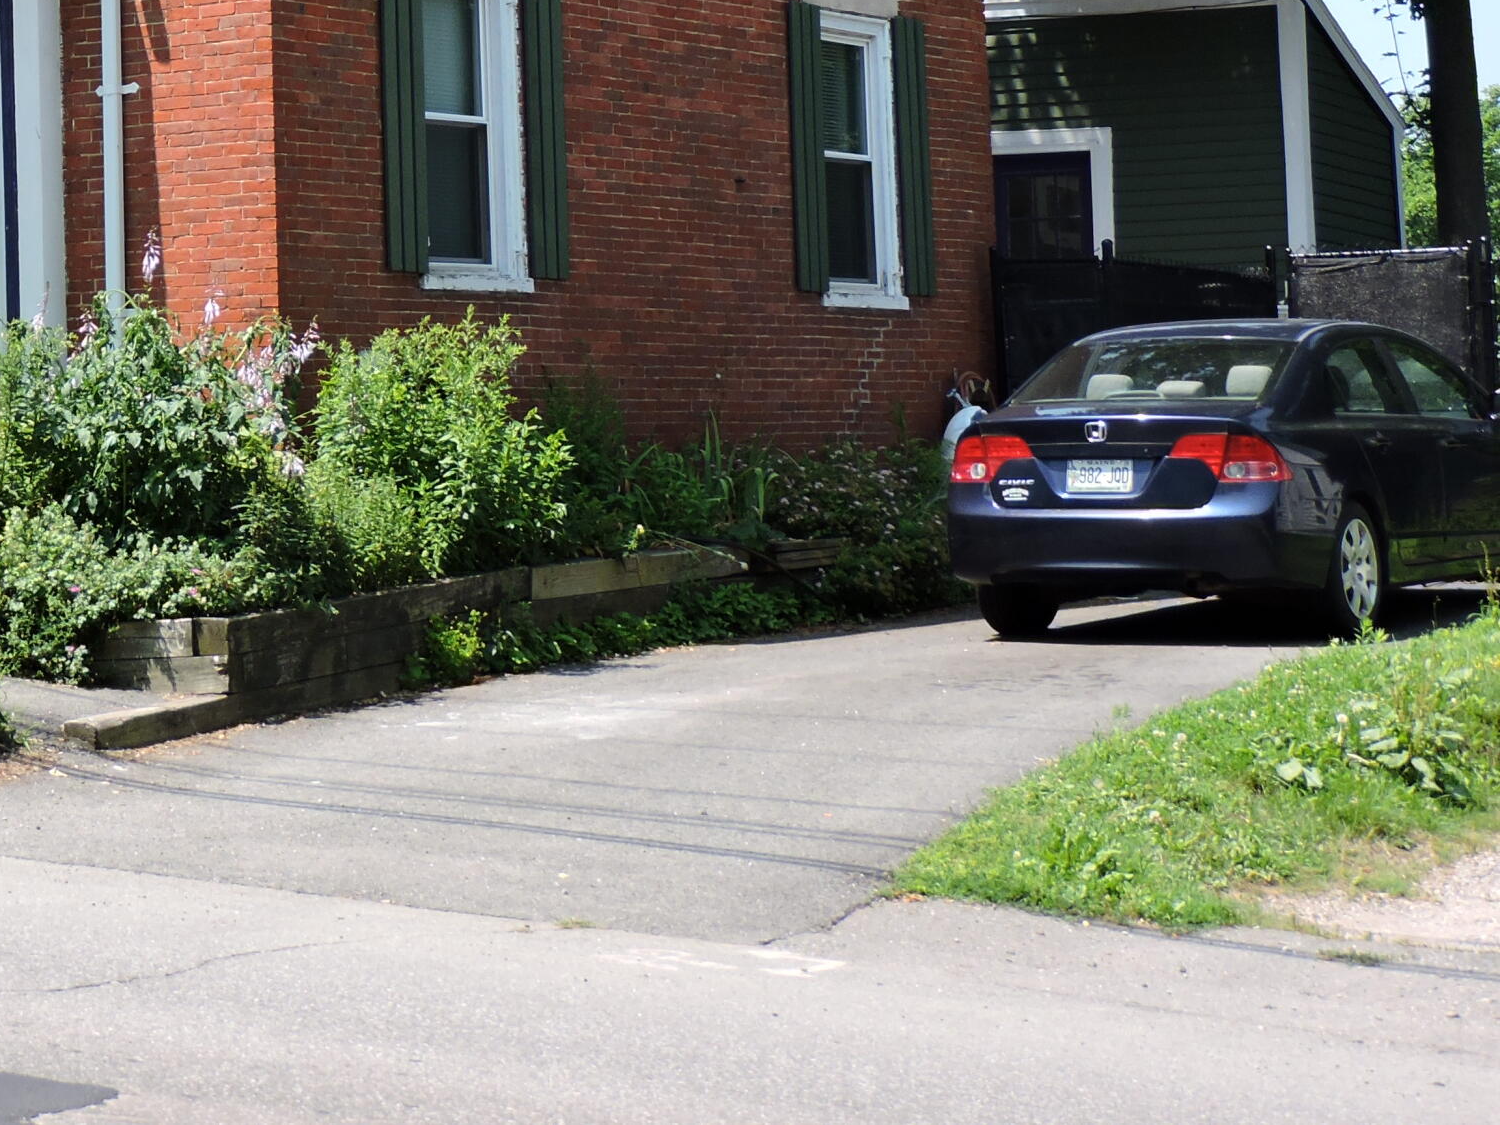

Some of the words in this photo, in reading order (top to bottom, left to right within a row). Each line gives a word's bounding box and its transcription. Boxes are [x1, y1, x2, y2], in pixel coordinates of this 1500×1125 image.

[1079, 467, 1102, 484] 982
[1106, 466, 1129, 484] JQD
[998, 478, 1035, 486] CIVIC
